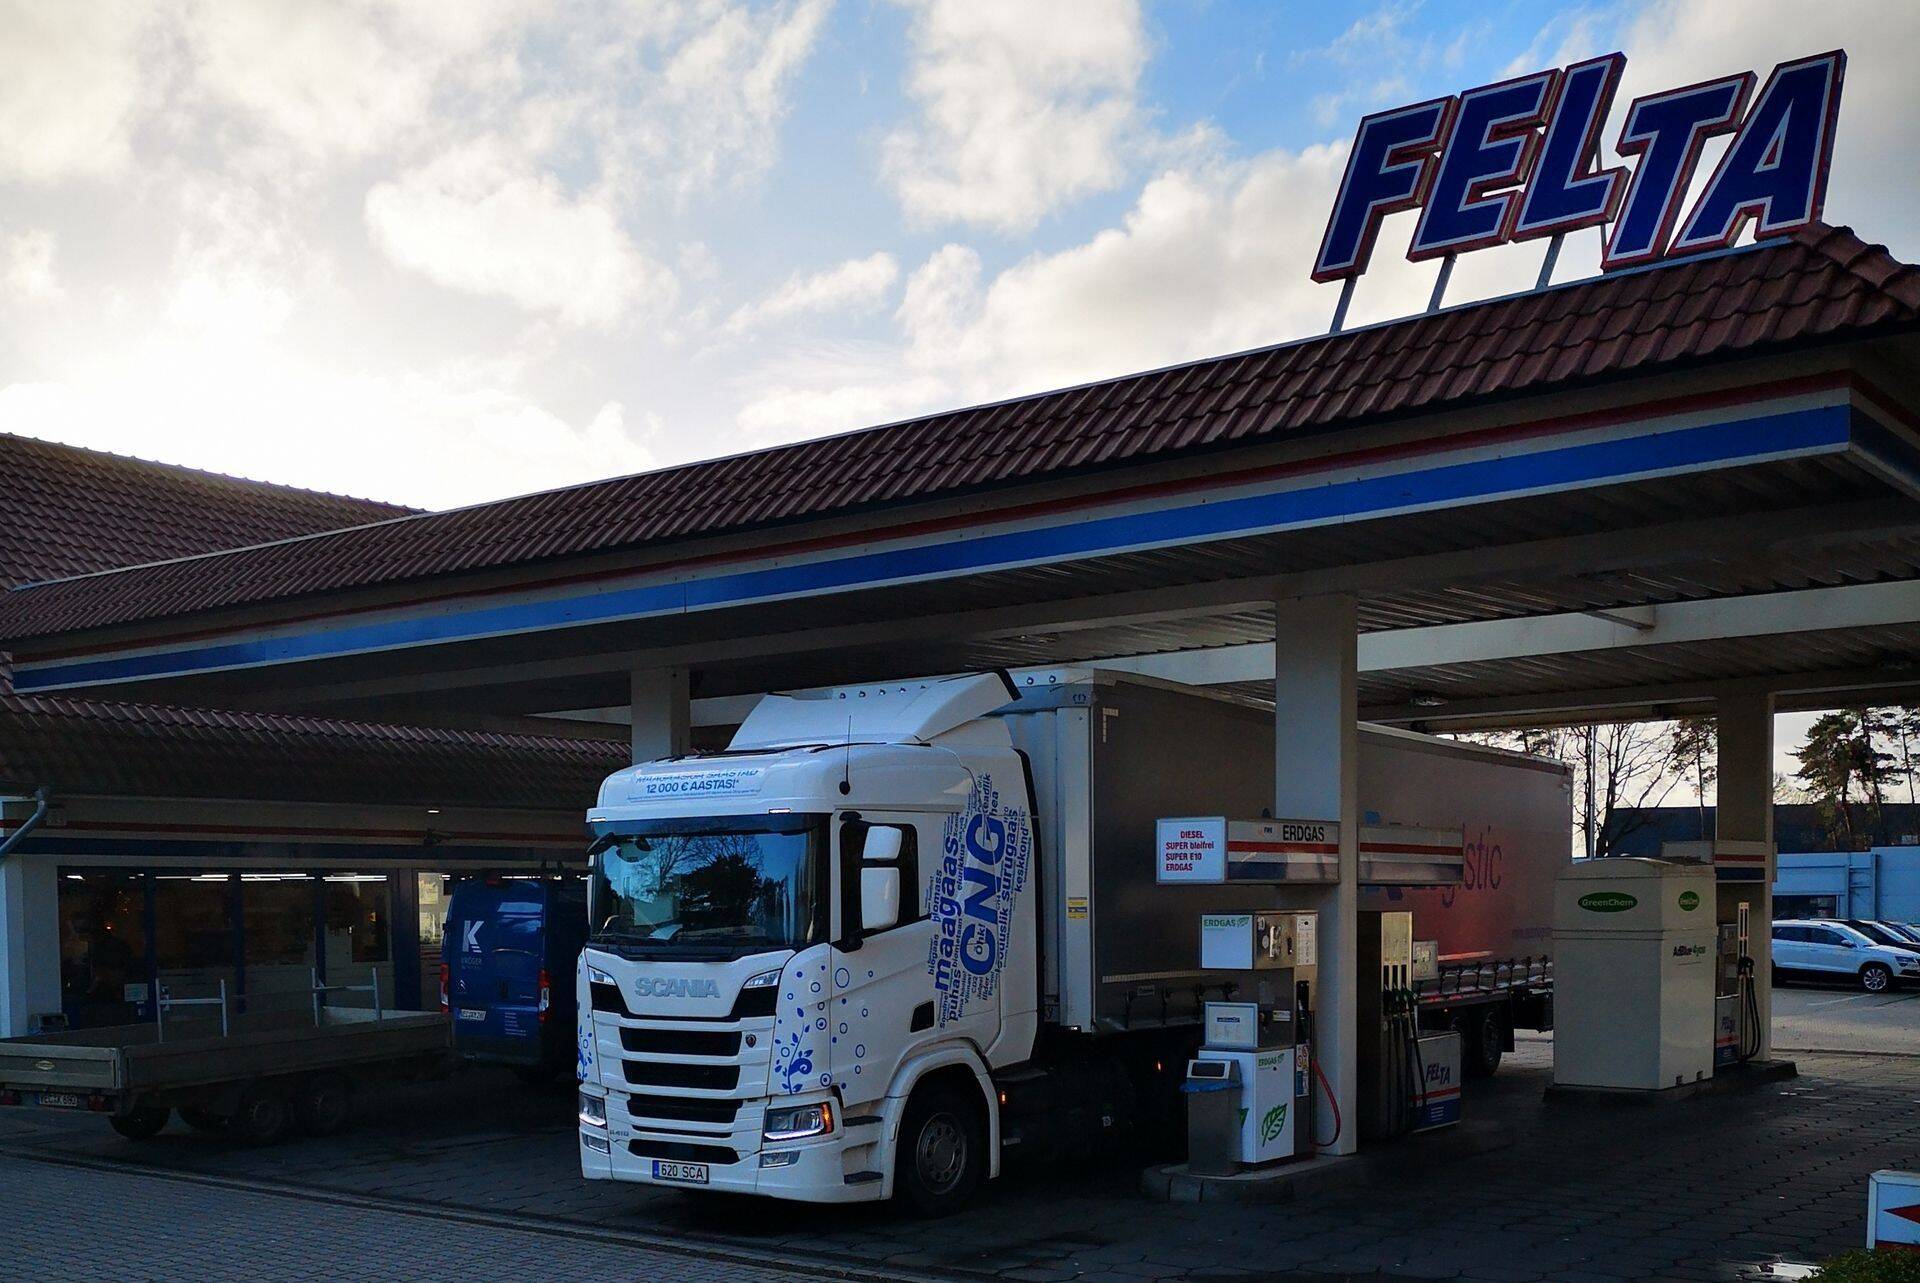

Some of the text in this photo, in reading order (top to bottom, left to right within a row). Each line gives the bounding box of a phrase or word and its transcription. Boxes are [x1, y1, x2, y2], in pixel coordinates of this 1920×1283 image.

[1310, 48, 1848, 284] FELTA
[646, 783, 656, 793] 12
[657, 781, 679, 792] 000
[681, 781, 689, 791] €
[988, 790, 999, 817] hea
[1180, 830, 1204, 839] DIESEL
[1282, 825, 1325, 842] ERDGAS
[1001, 808, 1019, 902] surugaas
[1166, 840, 1214, 851] SUPER bleifrei
[1013, 826, 1029, 893] keskkond
[1166, 852, 1202, 862] SUPER E10
[1166, 862, 1193, 872] ERDGAS
[930, 868, 942, 923] biomass
[959, 813, 1006, 976] CNG
[1581, 897, 1634, 908] GreenChem
[935, 834, 962, 992] maagaas
[1204, 918, 1235, 928] ERDGAS
[634, 977, 720, 998] SCANIA
[947, 969, 962, 1022] puhas
[1425, 1062, 1451, 1084] FELTA
[661, 1164, 704, 1179] 620 SCA
